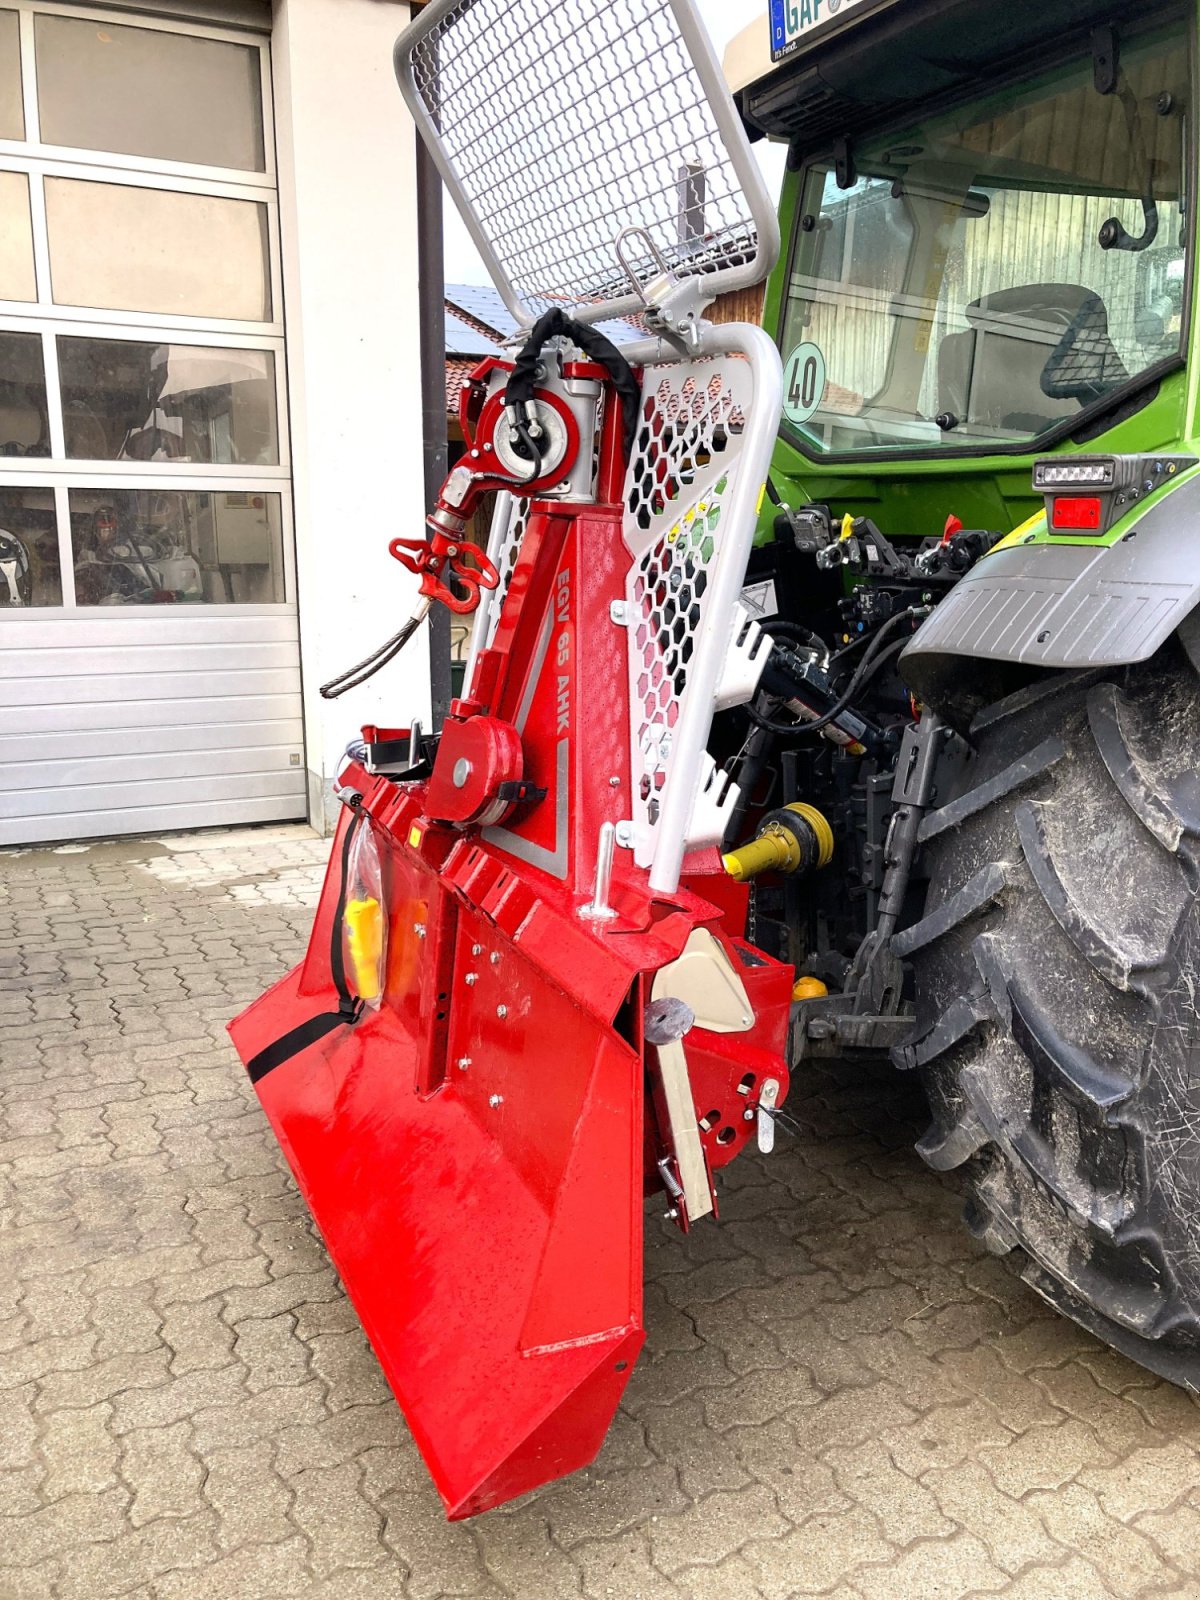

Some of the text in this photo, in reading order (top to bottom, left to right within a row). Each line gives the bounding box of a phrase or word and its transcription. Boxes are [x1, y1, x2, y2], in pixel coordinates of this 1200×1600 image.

[776, 27, 782, 39] D
[788, 356, 817, 409] 40
[557, 568, 570, 736] EGV 65 AHK
